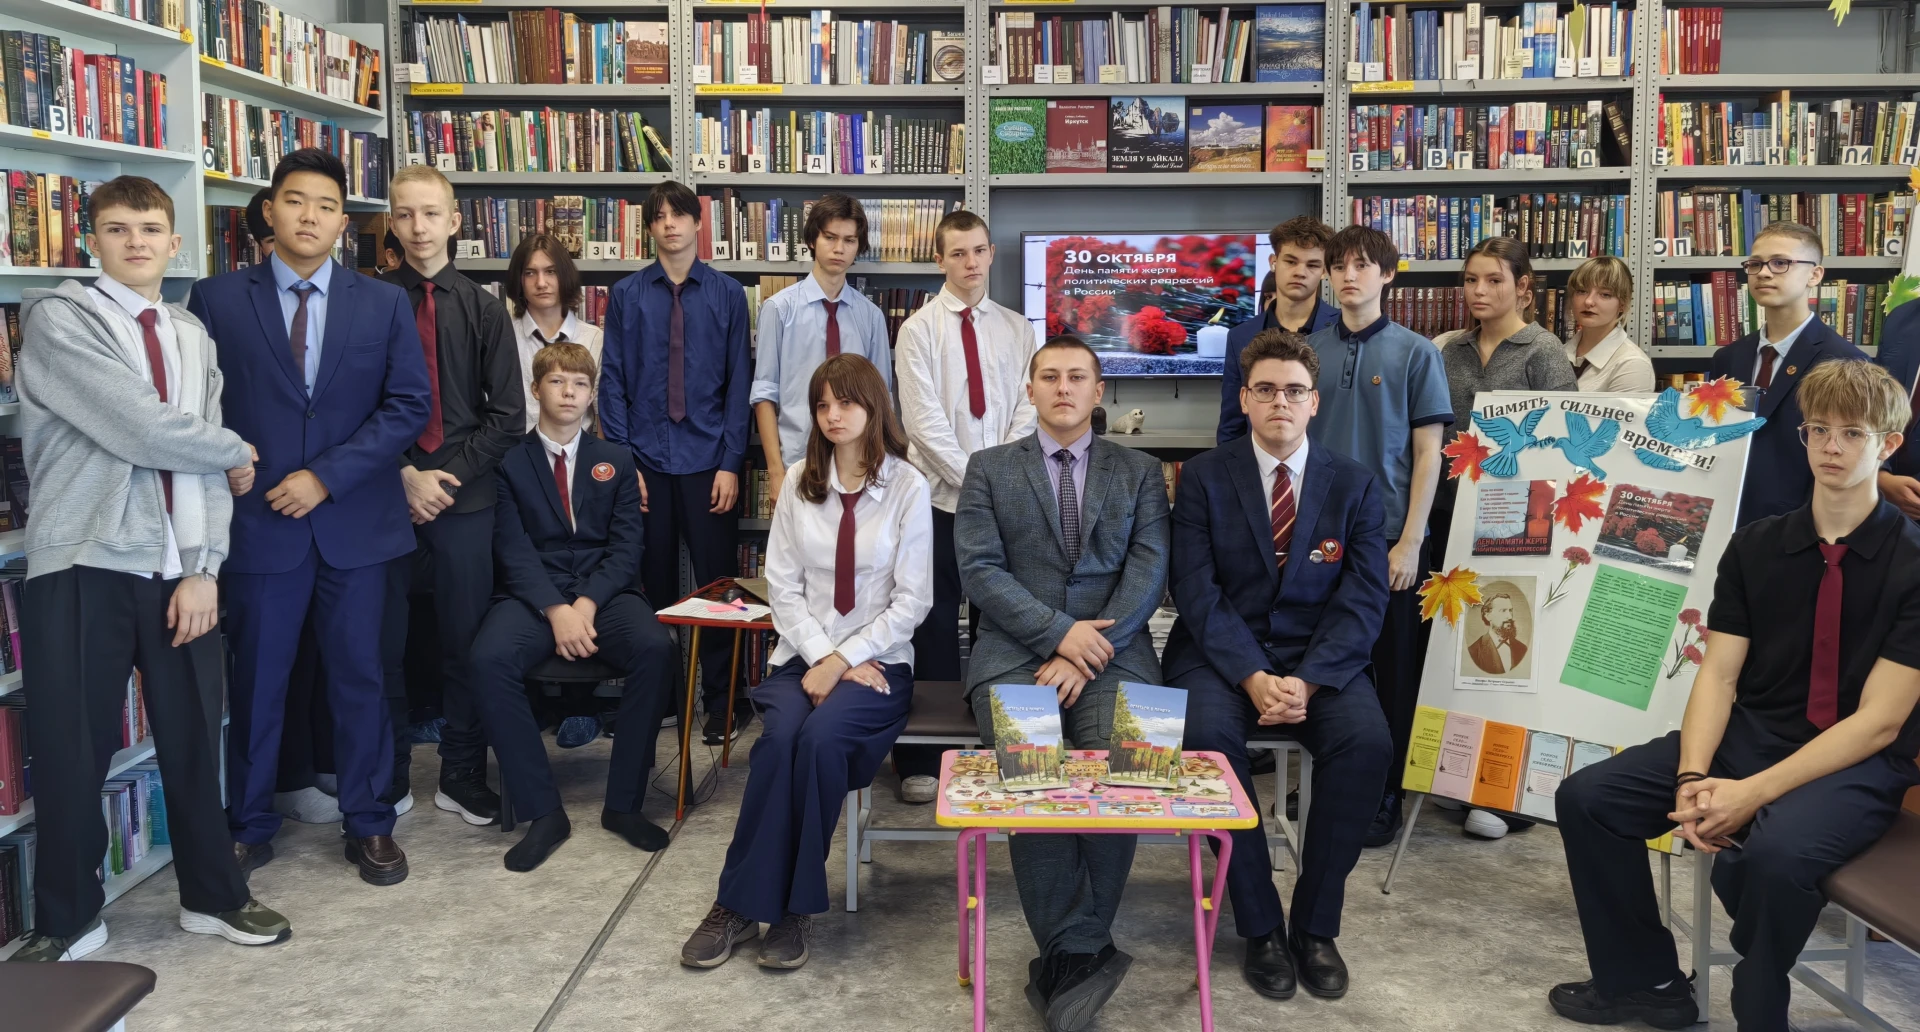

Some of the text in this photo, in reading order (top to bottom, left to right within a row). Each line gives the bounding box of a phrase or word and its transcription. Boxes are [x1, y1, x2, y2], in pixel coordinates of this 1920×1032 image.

[53, 108, 65, 132] З
[86, 121, 94, 139] К
[1146, 154, 1184, 162] БАЙКАЛА
[1431, 152, 1443, 166] В
[1459, 152, 1470, 169] Г
[1580, 151, 1593, 166] Д
[1655, 149, 1663, 164] Е
[1729, 150, 1741, 164] И
[1769, 149, 1780, 164] К
[1844, 147, 1858, 164] Л
[1903, 147, 1917, 164] Н
[410, 158, 418, 166] Б
[443, 158, 449, 168] Г
[697, 158, 706, 168] А
[718, 160, 726, 170] Б
[753, 159, 761, 169] В
[811, 159, 821, 170] Д
[870, 159, 878, 169] К
[1352, 154, 1364, 170] Б
[252, 158, 260, 179] П
[471, 245, 480, 256] Д
[593, 246, 600, 255] З
[609, 246, 617, 255] К
[716, 246, 725, 256] М
[745, 247, 753, 256] Н
[772, 246, 780, 256] П
[801, 247, 808, 256] Р
[1570, 241, 1586, 257] М
[1676, 240, 1687, 254] П
[1887, 239, 1898, 254] С
[1064, 250, 1176, 264] 30 ОКТЯБРЯ
[1063, 266, 1094, 276] День
[1141, 267, 1177, 275] жертв
[1064, 276, 1214, 286] политических репрессий
[1074, 287, 1116, 296] России
[1482, 397, 1635, 423] Память сильнее
[1621, 429, 1716, 470] времи!
[1620, 490, 1673, 507] 30 ОКТЯБРЯ
[1496, 537, 1524, 545] ПАМЯТИ
[1524, 537, 1548, 545] ЖЕРТВ
